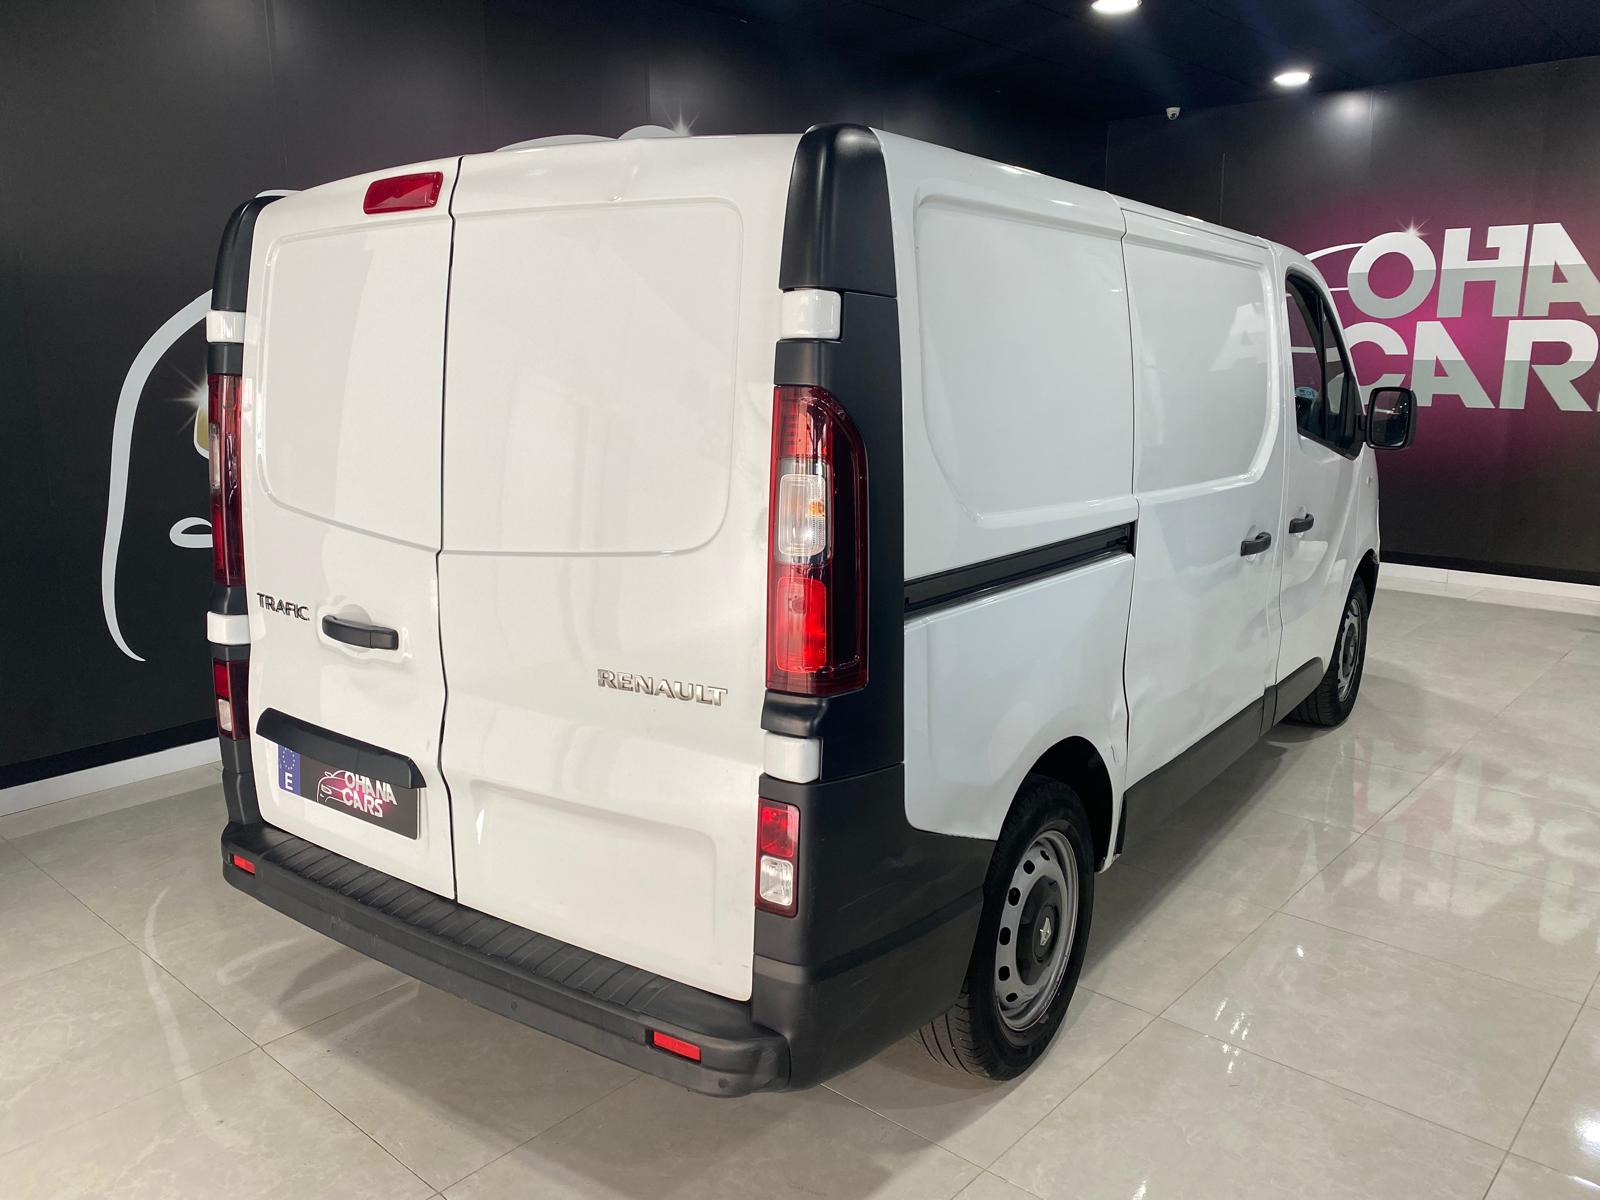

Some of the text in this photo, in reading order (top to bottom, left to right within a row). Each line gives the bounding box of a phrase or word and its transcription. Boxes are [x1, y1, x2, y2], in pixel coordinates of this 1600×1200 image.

[1347, 222, 1600, 319] OHA
[1342, 318, 1600, 412] CAR
[256, 592, 310, 621] TRAFIC
[597, 668, 728, 707] RENAULT
[284, 771, 294, 791] E
[344, 771, 397, 806] OHANA
[342, 787, 383, 818] CARS
